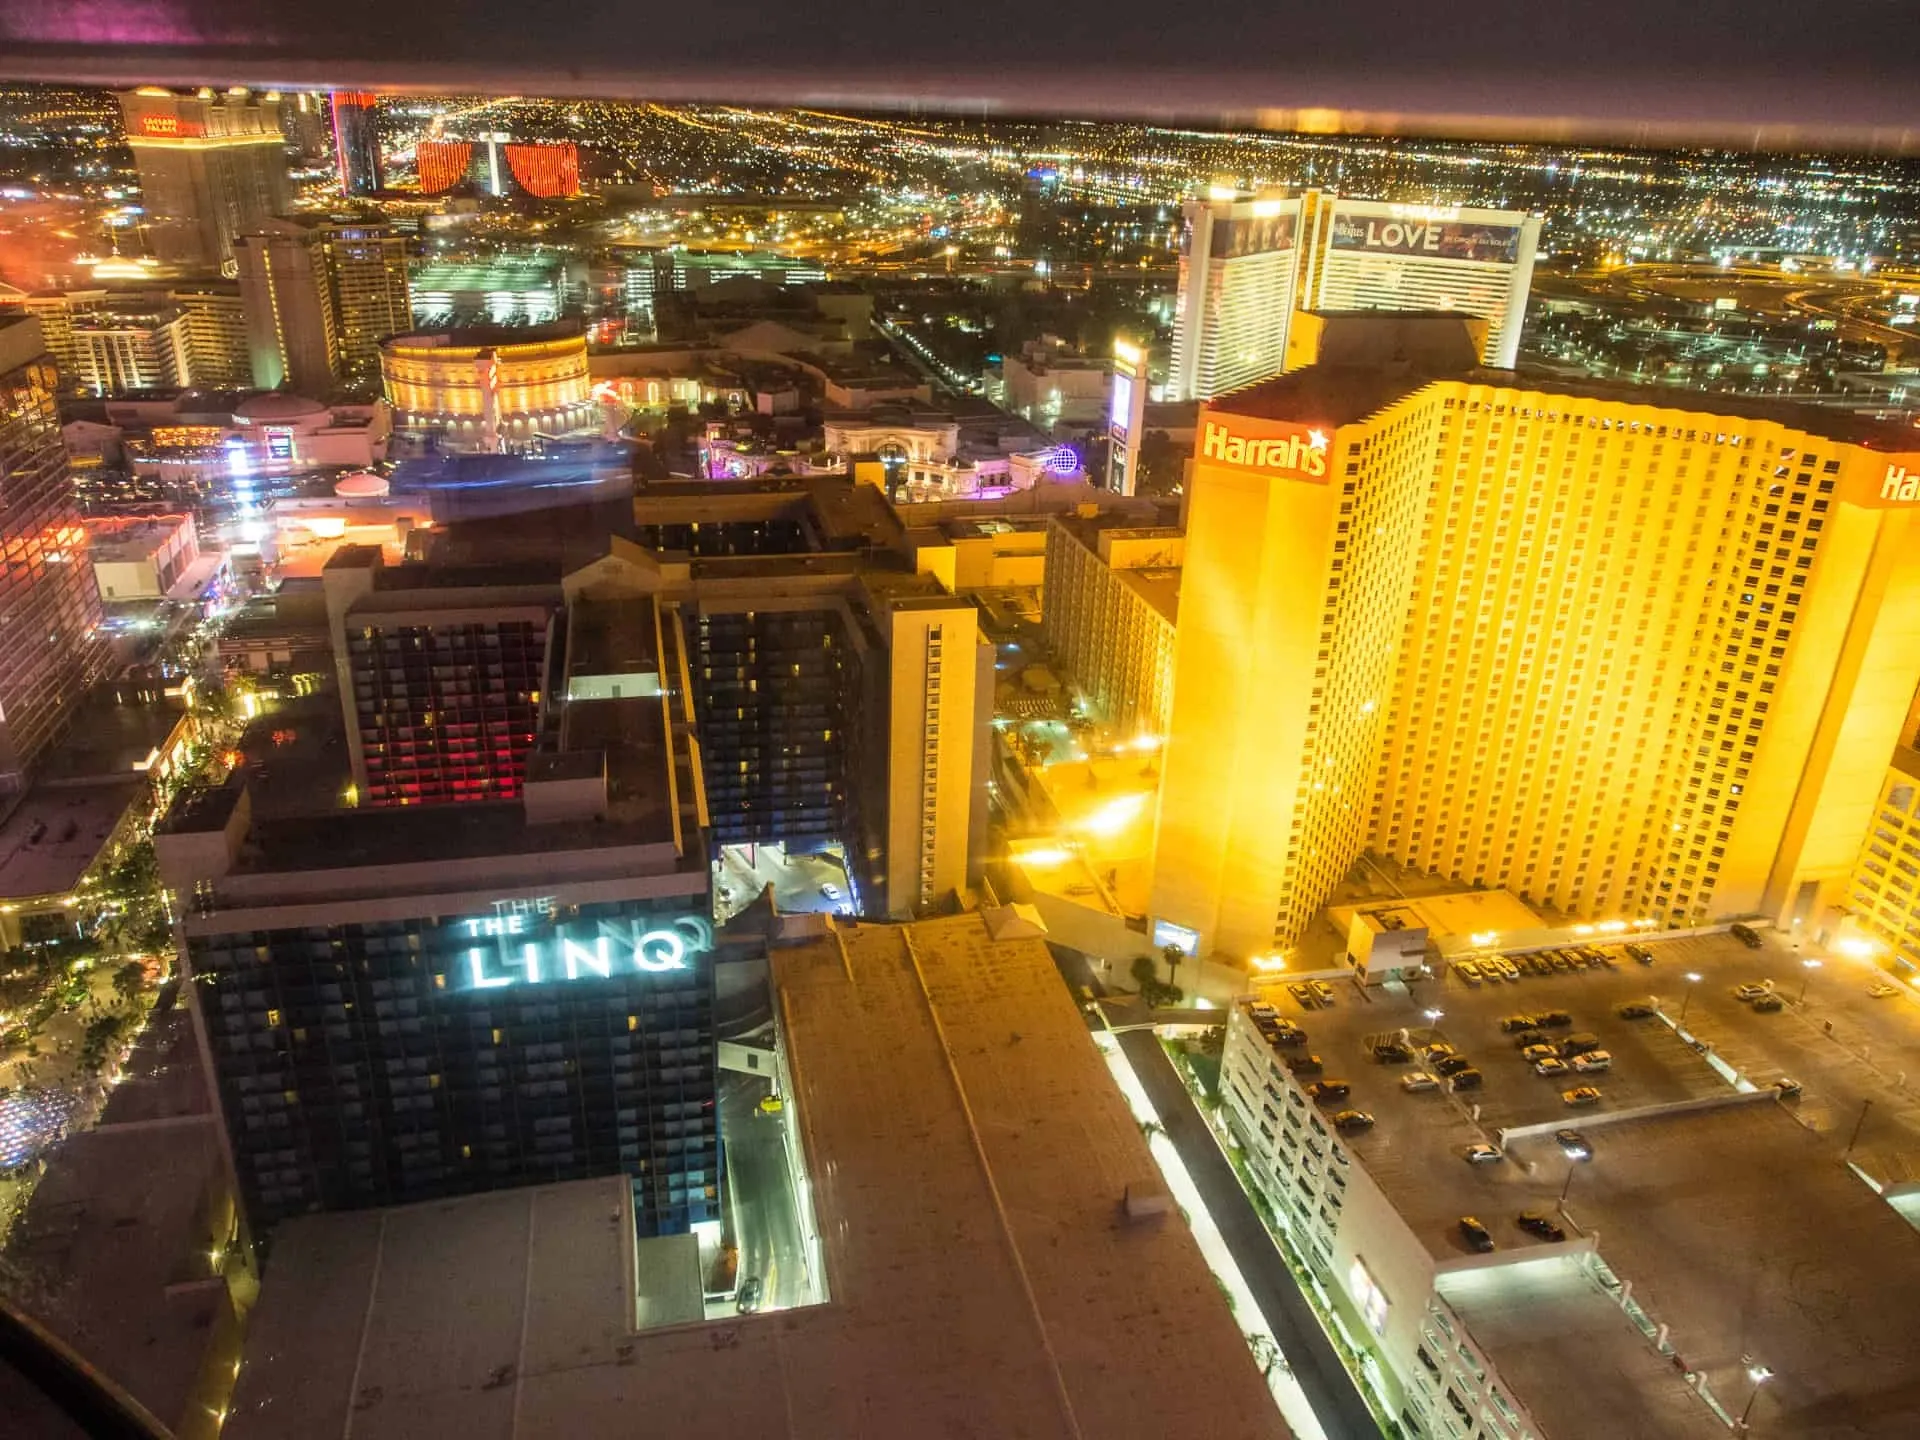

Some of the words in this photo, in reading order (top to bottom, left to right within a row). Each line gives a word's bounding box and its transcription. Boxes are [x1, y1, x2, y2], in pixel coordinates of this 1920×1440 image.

[1366, 221, 1443, 251] LOVE
[1880, 463, 1920, 501] Ha
[466, 915, 524, 938] THE
[469, 930, 687, 989] LINQ
